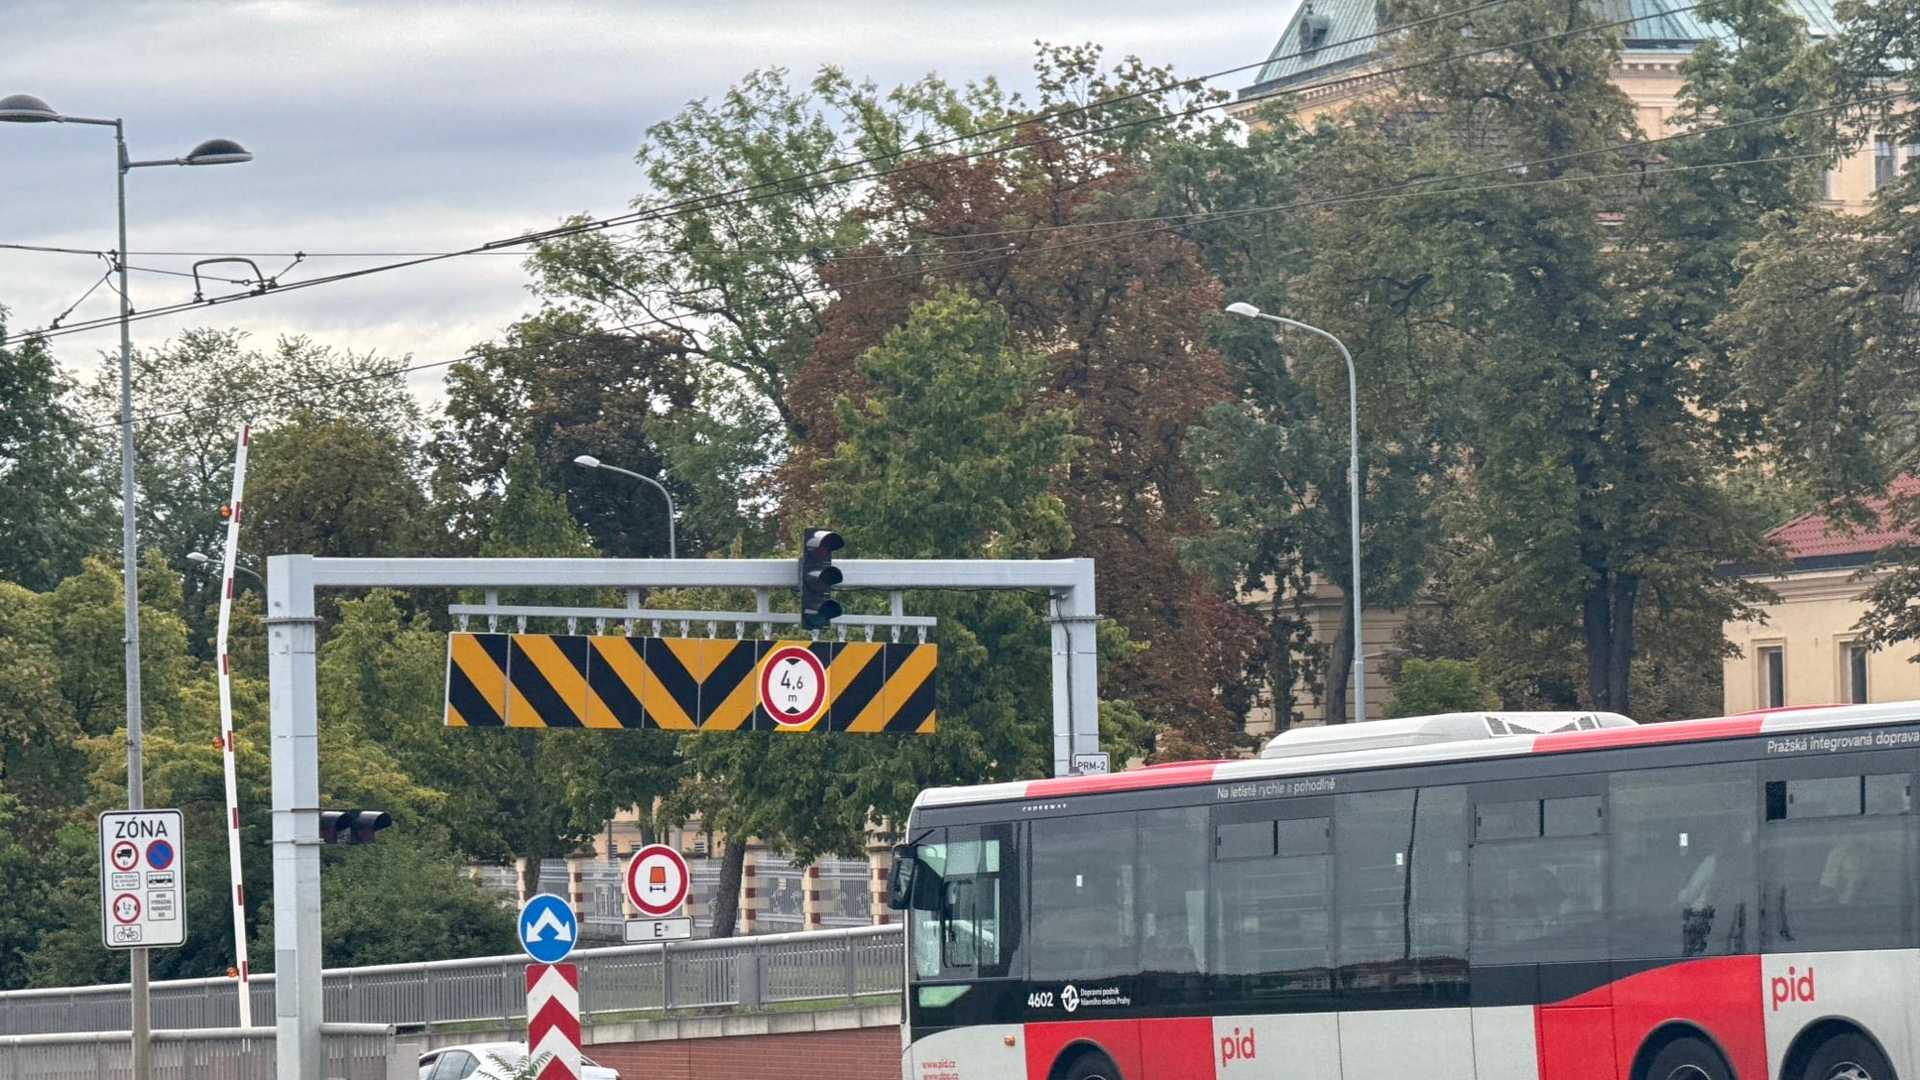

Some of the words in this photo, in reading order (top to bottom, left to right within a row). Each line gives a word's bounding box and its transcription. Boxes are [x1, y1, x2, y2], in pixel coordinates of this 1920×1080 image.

[780, 670, 804, 691] 4,6
[787, 694, 798, 702] m
[1767, 737, 1808, 753] Pražská
[1810, 731, 1874, 751] integrovaná
[1876, 731, 1920, 747] doprava
[1077, 761, 1106, 770] PRM-2
[1217, 787, 1229, 799] Na
[1259, 782, 1285, 797] rychle
[115, 816, 168, 839] ZÓNA
[1771, 966, 1815, 1011] pid
[1027, 992, 1054, 1008] 4602
[1221, 1027, 1256, 1068] pid
